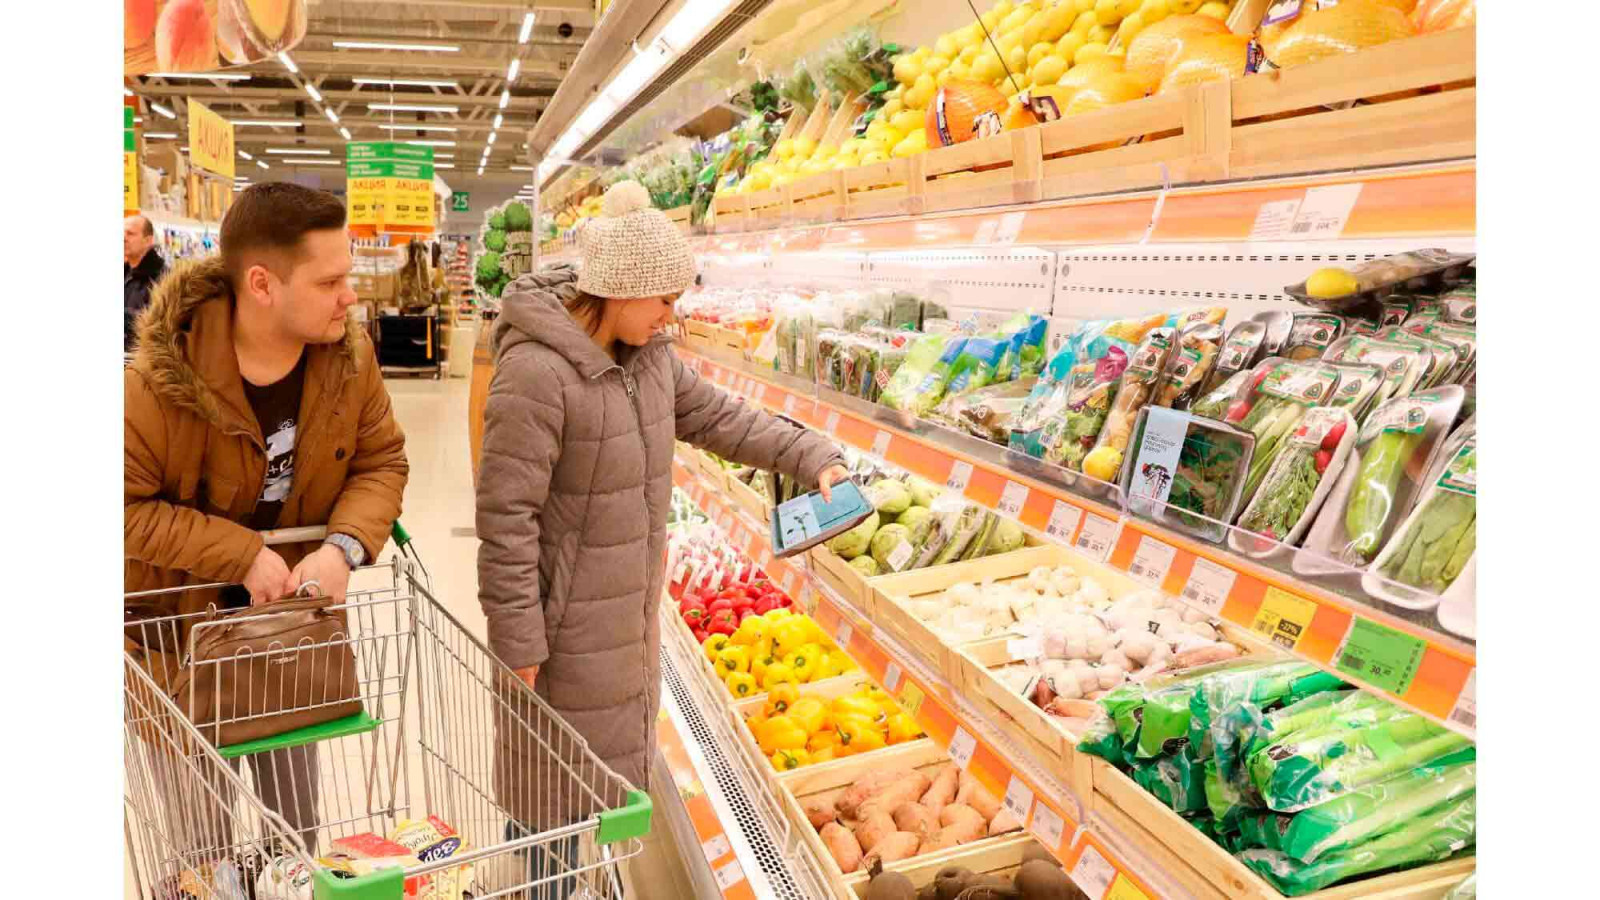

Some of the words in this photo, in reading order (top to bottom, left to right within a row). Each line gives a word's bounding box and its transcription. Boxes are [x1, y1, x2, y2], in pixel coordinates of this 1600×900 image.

[198, 115, 229, 164] АКЦИЯ
[352, 179, 386, 190] АКЦИЯ
[395, 180, 430, 191] АКЦИЯ
[454, 194, 468, 209] 25
